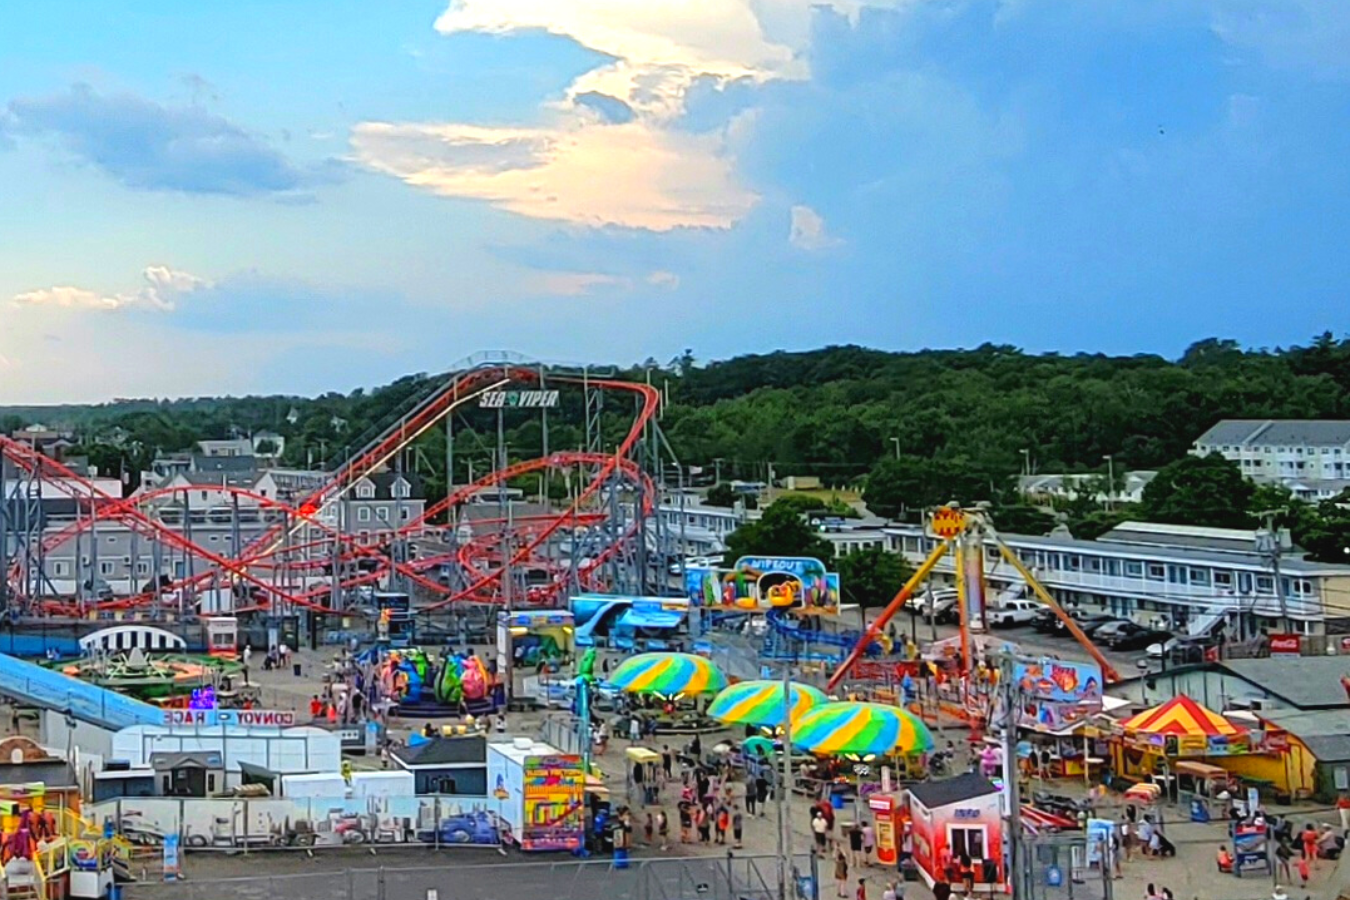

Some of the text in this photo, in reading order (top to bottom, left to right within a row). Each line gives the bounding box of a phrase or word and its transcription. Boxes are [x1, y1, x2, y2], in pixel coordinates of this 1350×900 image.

[479, 390, 559, 408] SEA VIPER
[751, 558, 802, 570] WIPEOUT
